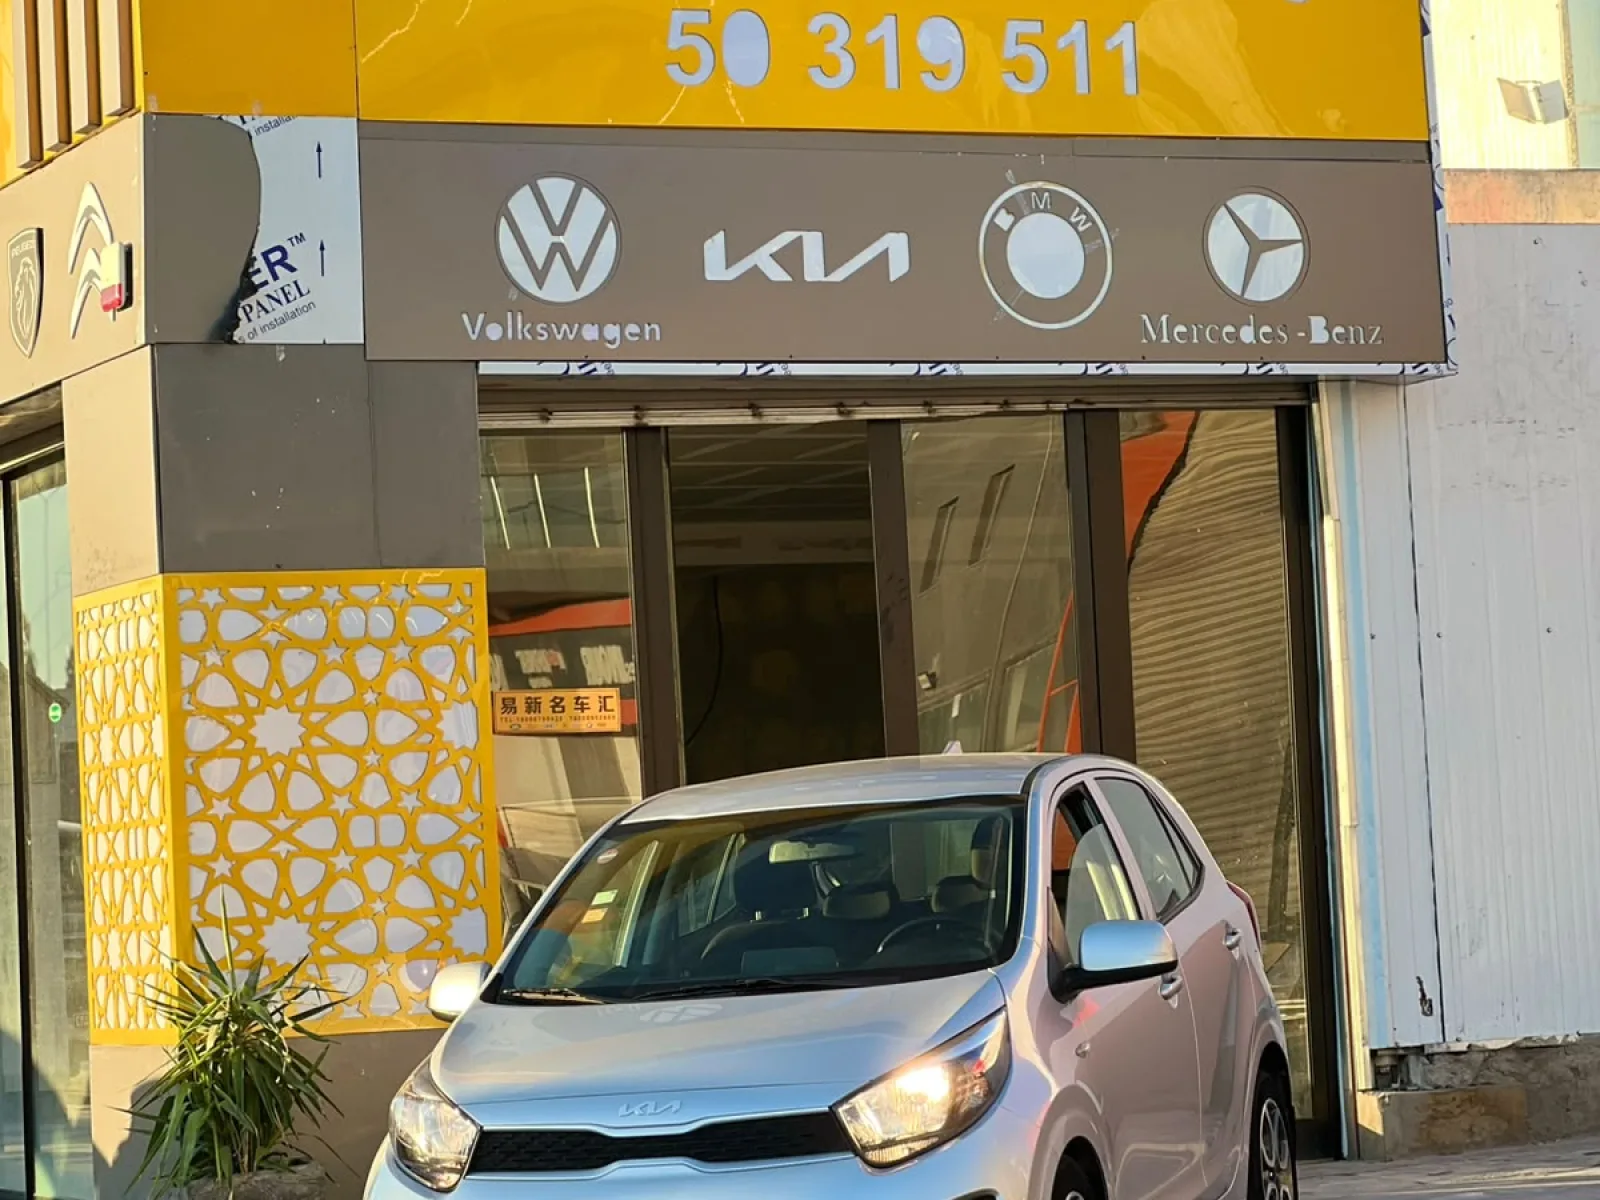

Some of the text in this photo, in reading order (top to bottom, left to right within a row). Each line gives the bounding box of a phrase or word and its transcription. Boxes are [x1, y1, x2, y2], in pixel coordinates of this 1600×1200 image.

[665, 9, 1139, 96] 50 319 511
[703, 230, 909, 283] KIA
[240, 280, 311, 324] PANEL
[260, 300, 316, 334] installation
[462, 313, 663, 349] Volkswagen
[1140, 314, 1289, 345] Mercedes
[501, 695, 615, 714] 易新名车汇
[618, 1100, 682, 1118] KIA
